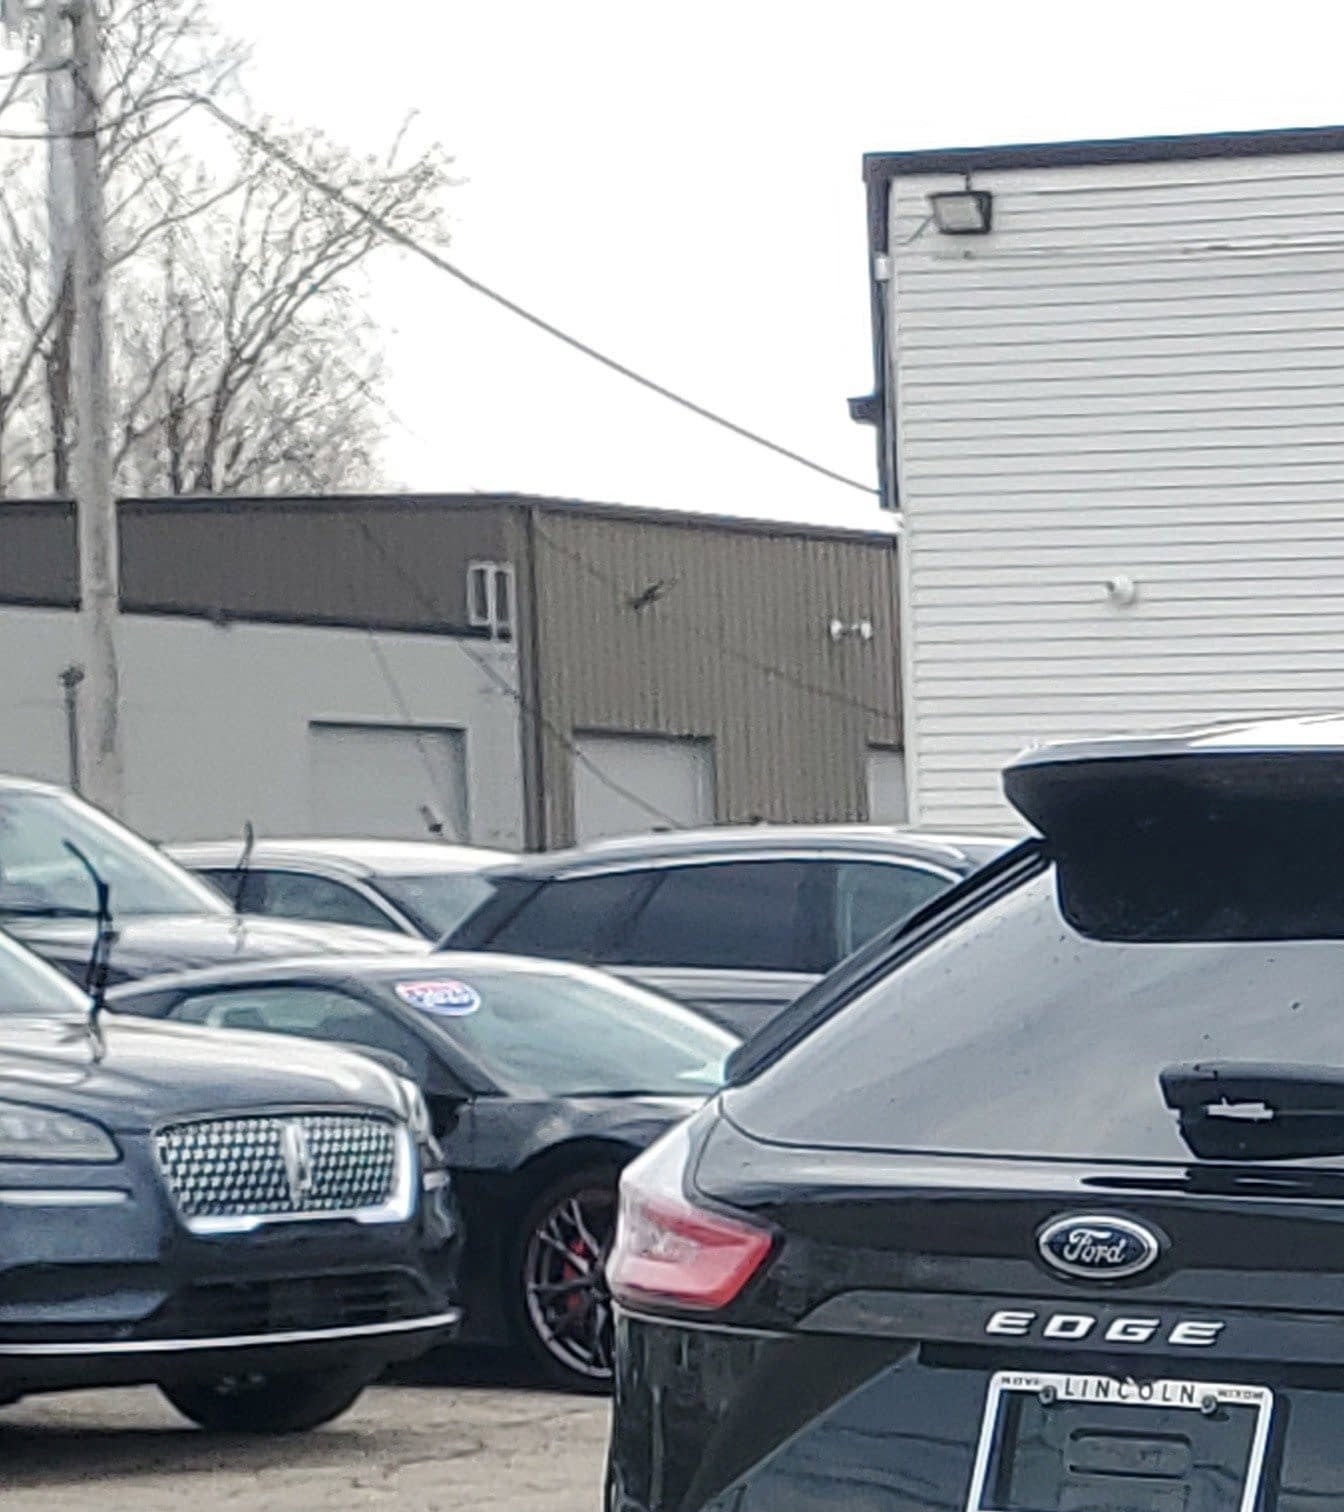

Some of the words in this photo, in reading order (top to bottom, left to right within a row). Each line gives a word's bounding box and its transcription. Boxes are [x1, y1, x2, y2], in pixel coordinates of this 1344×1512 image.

[1063, 1228, 1126, 1263] Ford
[986, 1311, 1226, 1346] EDGE
[1064, 1377, 1196, 1404] LINCOLN
